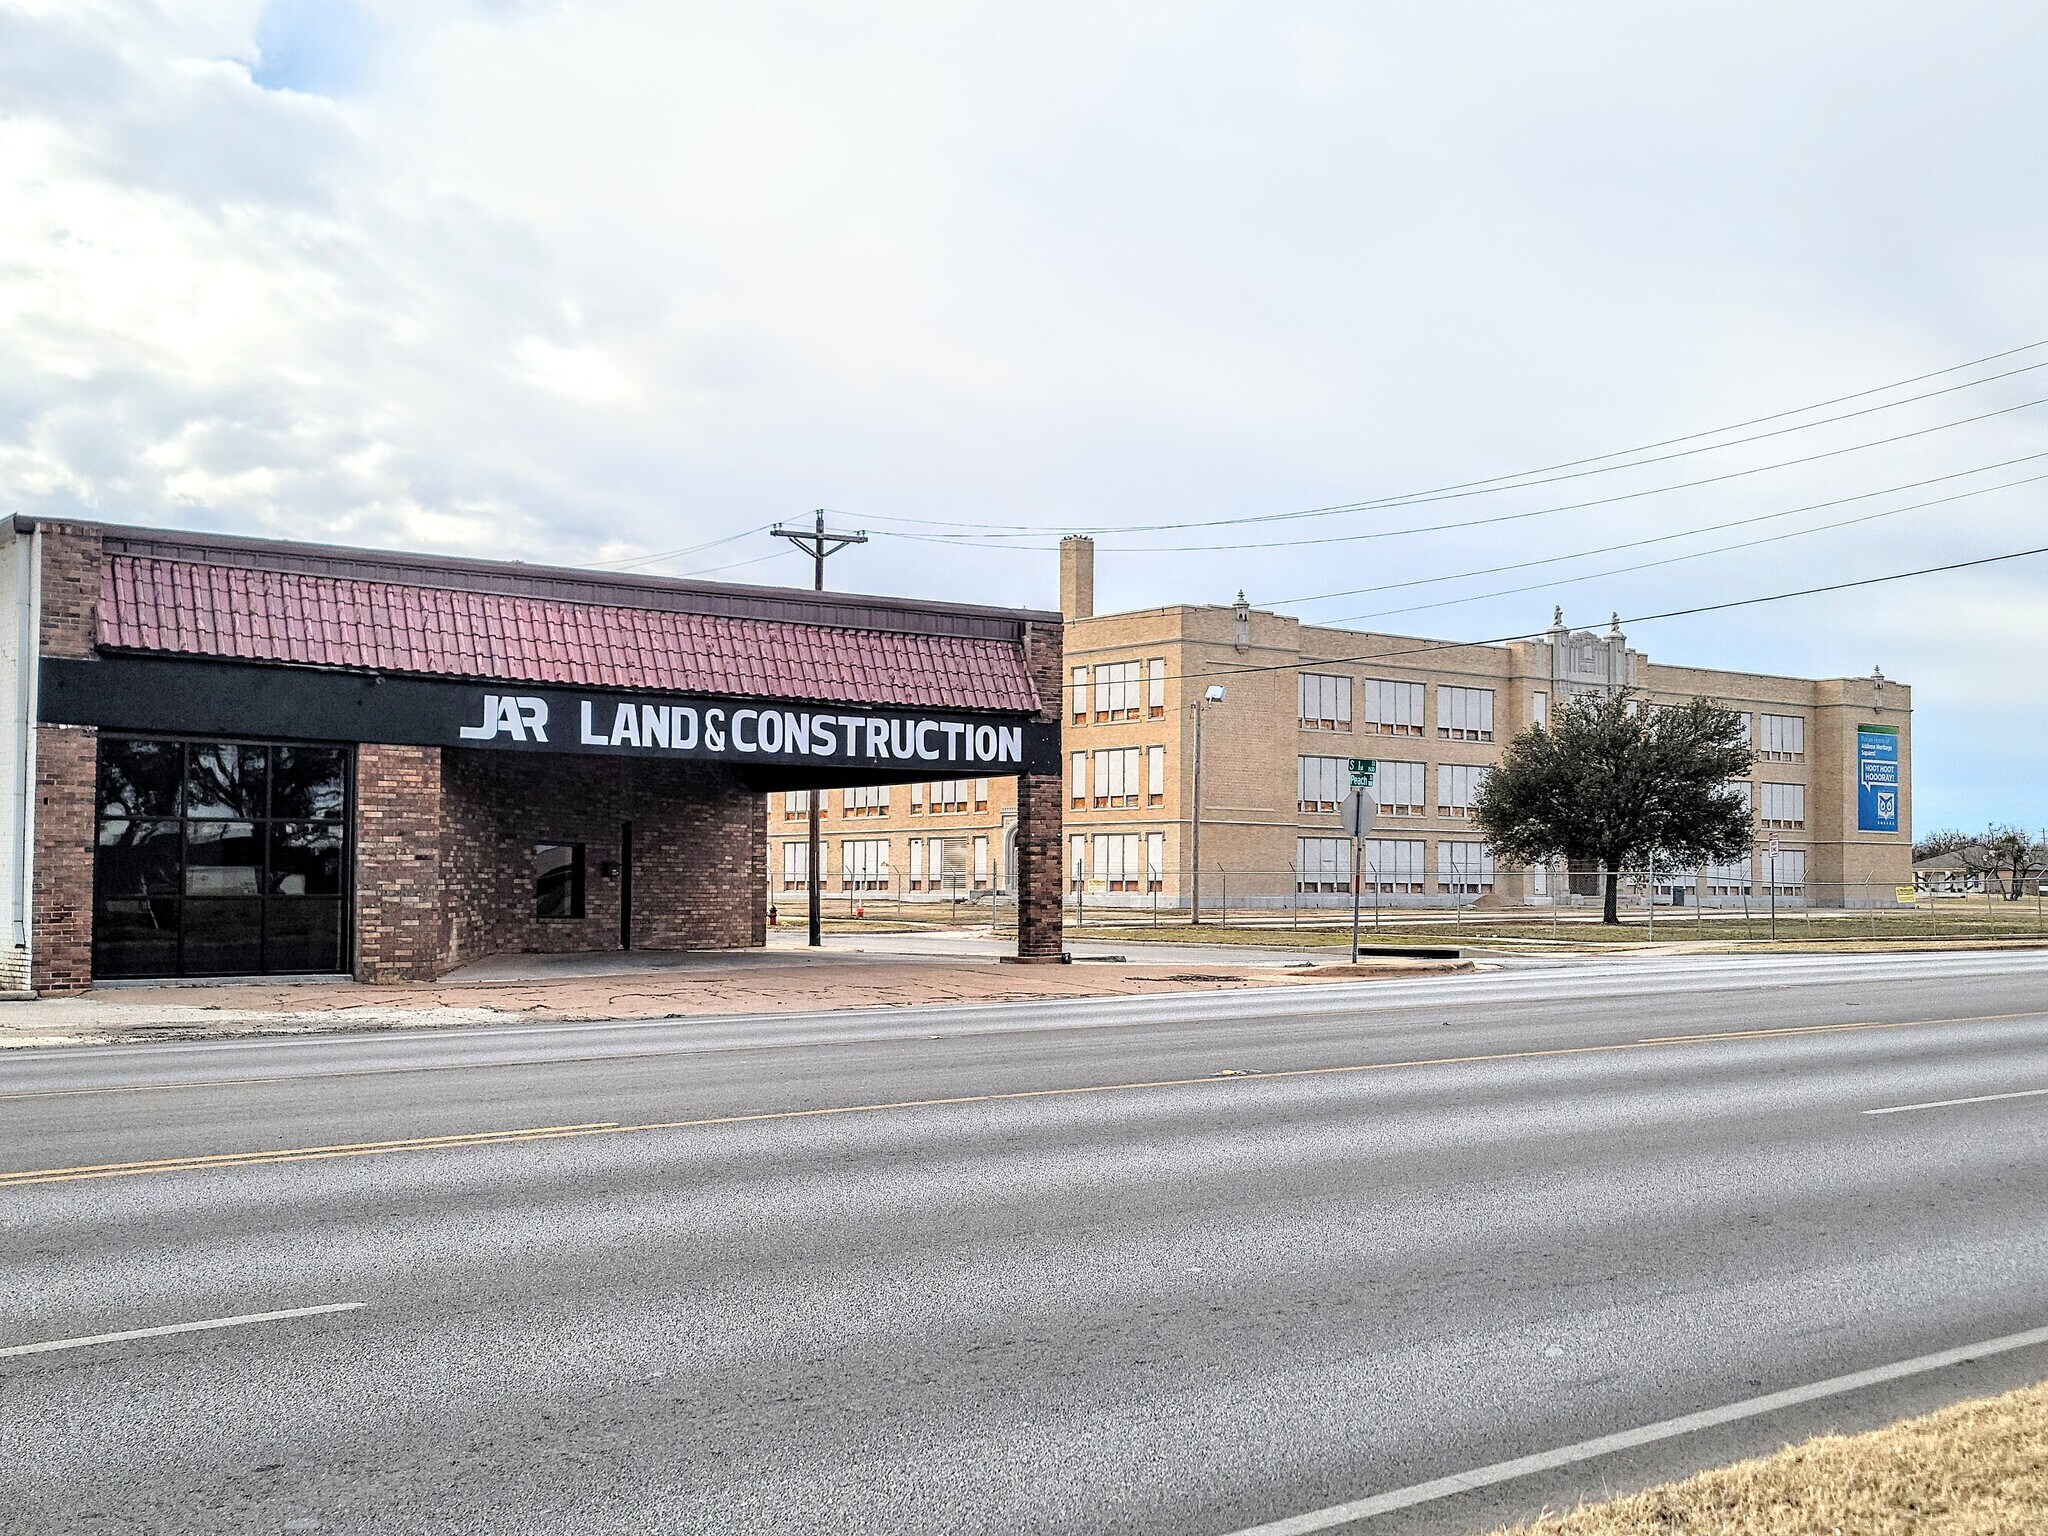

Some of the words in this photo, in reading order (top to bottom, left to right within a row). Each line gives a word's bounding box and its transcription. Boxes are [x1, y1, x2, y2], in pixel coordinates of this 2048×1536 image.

[459, 695, 549, 743] JAR
[581, 700, 699, 750] LAND
[731, 709, 1022, 763] CONSTRUCTION
[1865, 765, 1880, 773] HOOT
[1880, 765, 1894, 774] HOOT
[1350, 775, 1367, 785] Peach
